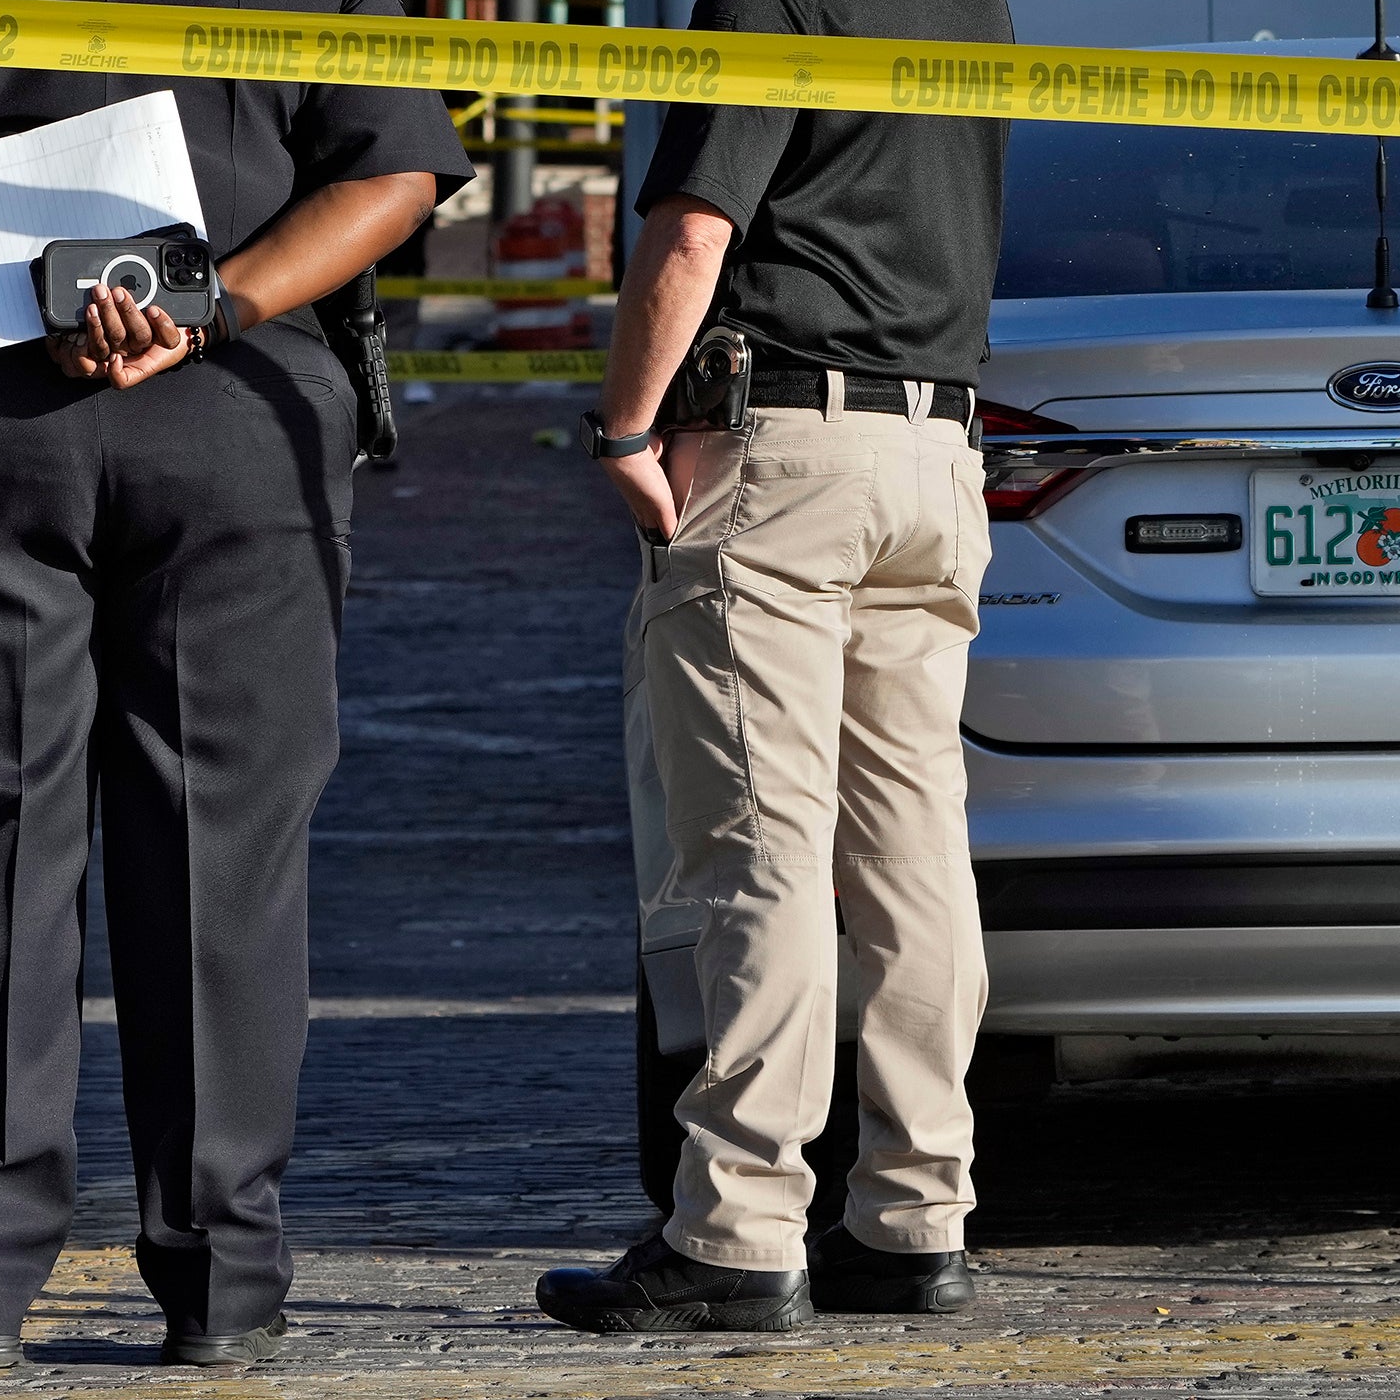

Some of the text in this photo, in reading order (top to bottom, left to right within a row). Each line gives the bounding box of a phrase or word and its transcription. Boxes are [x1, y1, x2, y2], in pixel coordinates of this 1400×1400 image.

[1266, 505, 1355, 566] 612
[1311, 572, 1330, 586] IN
[1337, 571, 1376, 585] GOD
